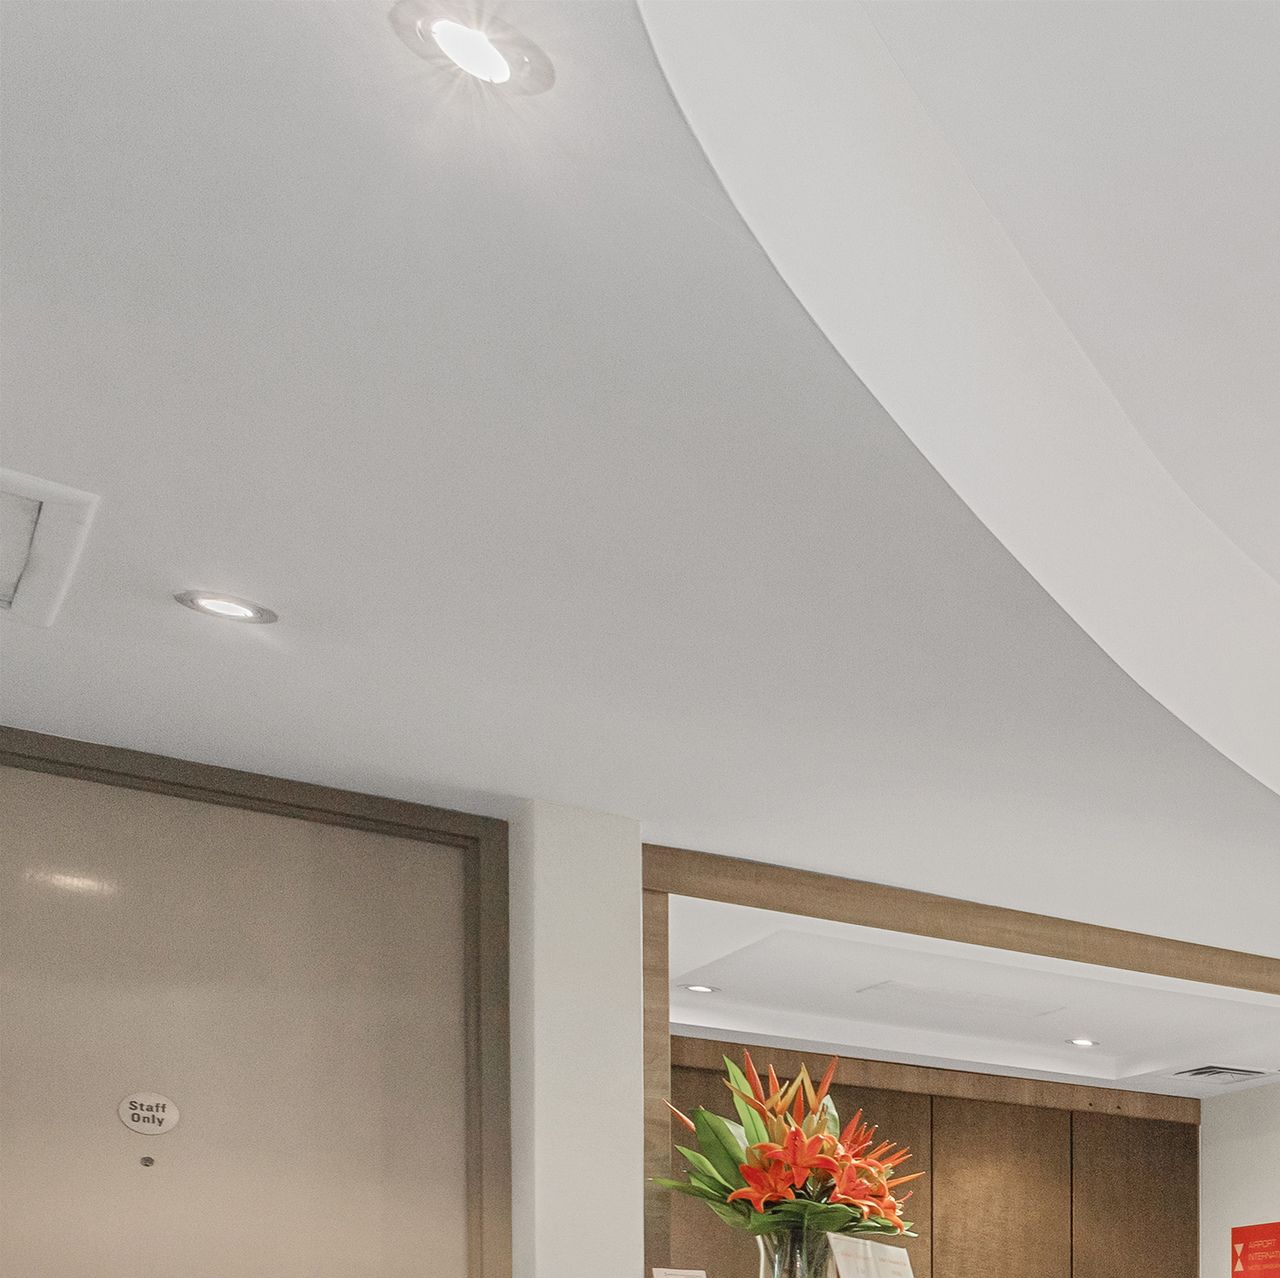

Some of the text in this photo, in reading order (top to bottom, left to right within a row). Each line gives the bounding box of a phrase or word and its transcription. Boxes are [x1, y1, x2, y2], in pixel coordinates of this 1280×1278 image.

[129, 1100, 167, 1113] Staff
[131, 1112, 165, 1127] Only
[1248, 1238, 1278, 1249] AIRPORT
